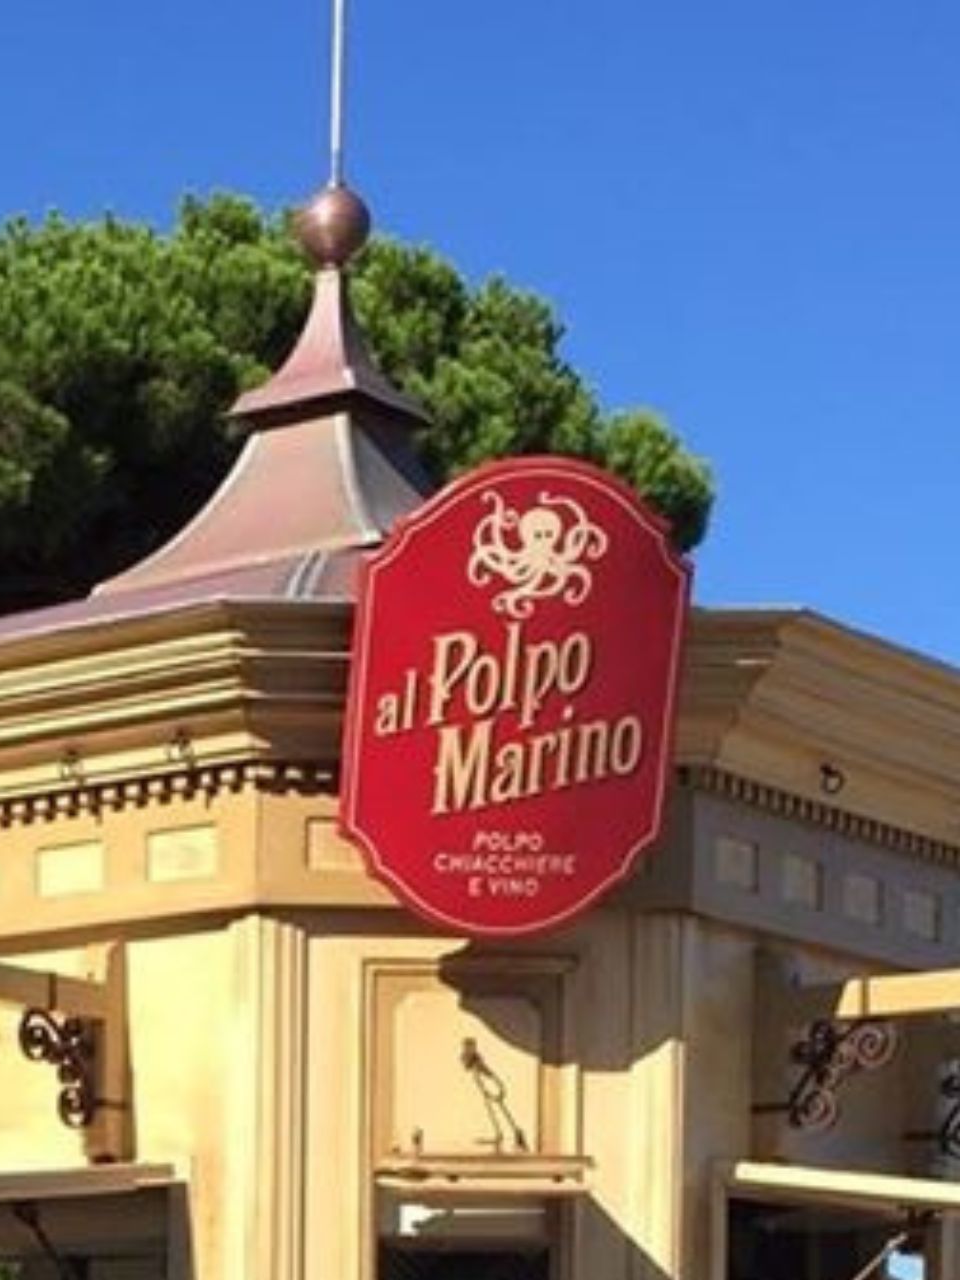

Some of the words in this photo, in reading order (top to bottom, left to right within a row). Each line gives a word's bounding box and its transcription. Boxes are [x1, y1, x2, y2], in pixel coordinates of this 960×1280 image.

[375, 670, 417, 735] al
[429, 621, 591, 728] Polpo
[431, 706, 642, 815] Marino
[473, 831, 544, 851] POLPO
[468, 876, 482, 897] E
[489, 877, 539, 897] VINO
